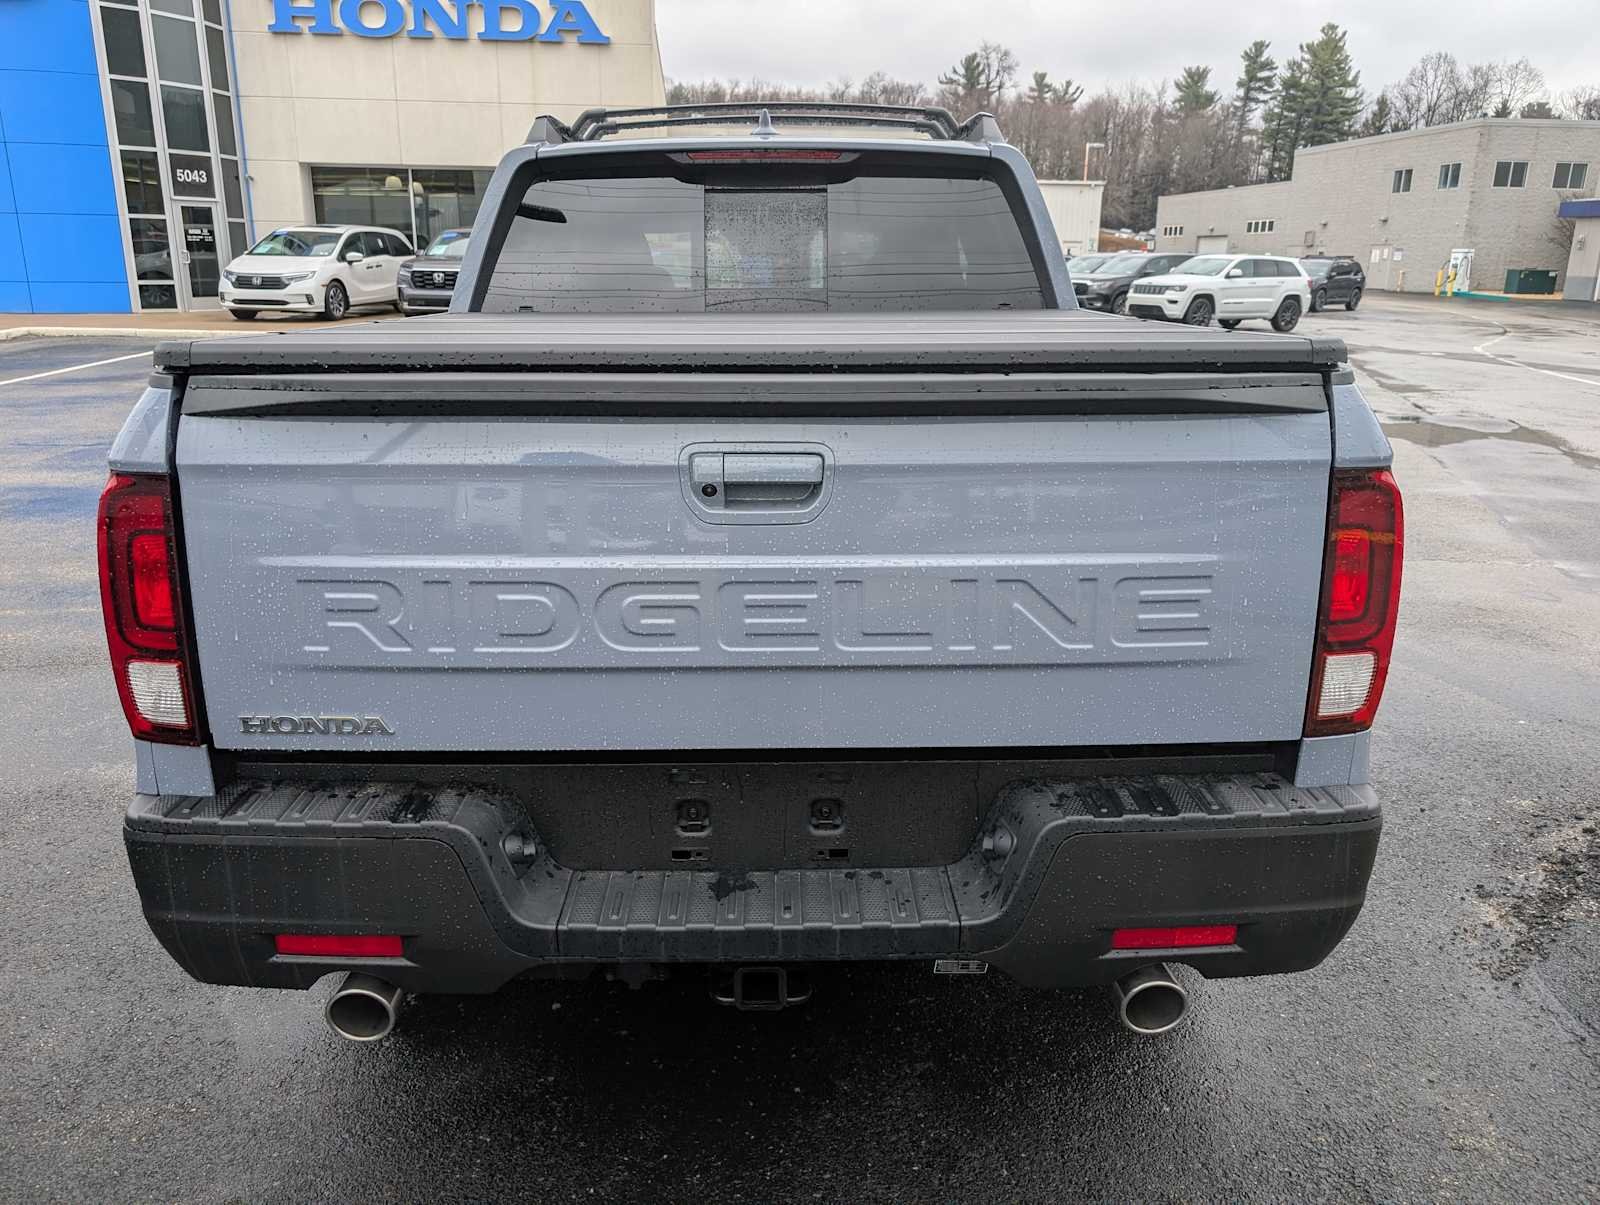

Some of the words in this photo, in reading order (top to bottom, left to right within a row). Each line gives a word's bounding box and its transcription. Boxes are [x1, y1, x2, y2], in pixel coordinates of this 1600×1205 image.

[268, 0, 610, 44] HONDA
[176, 168, 208, 183] 5043
[296, 574, 1214, 653] RIDGELINE
[238, 714, 395, 735] HONDA
